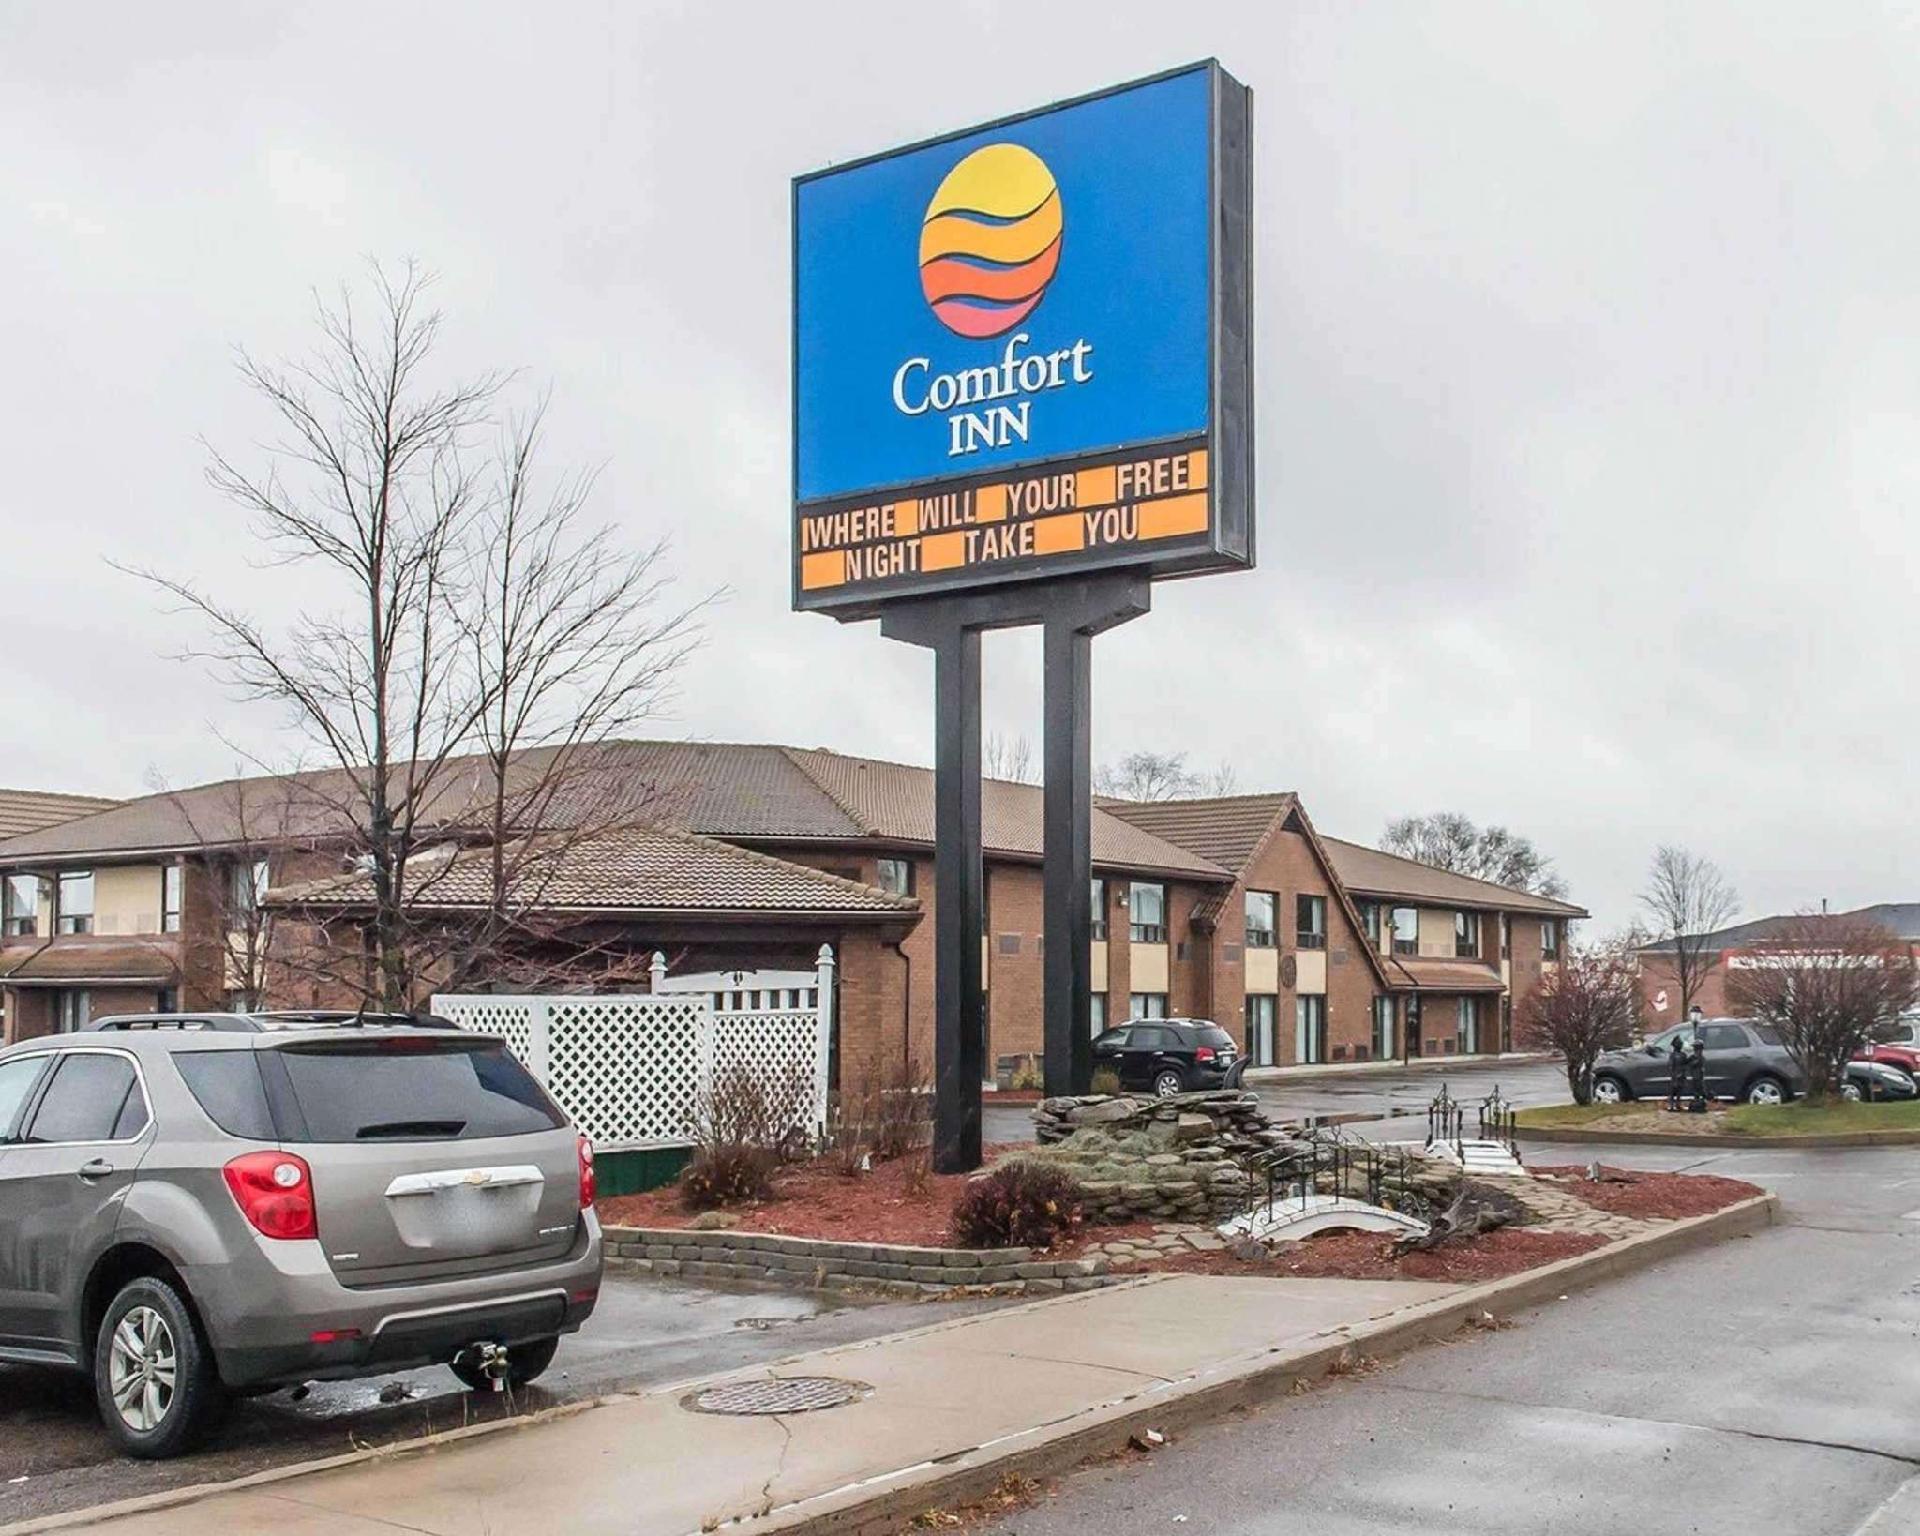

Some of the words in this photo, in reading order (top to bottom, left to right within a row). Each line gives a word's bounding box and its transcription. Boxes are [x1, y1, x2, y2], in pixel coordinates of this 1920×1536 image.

[893, 333, 1094, 415] Comfort
[949, 401, 1031, 456] INN
[809, 504, 895, 549] WHERE
[919, 491, 976, 532] WILL
[1007, 473, 1076, 517] YOUR
[1117, 455, 1188, 500] FREE
[846, 538, 921, 582] NIGHT
[966, 521, 1034, 564] TAKE
[1085, 504, 1138, 546] YOU
